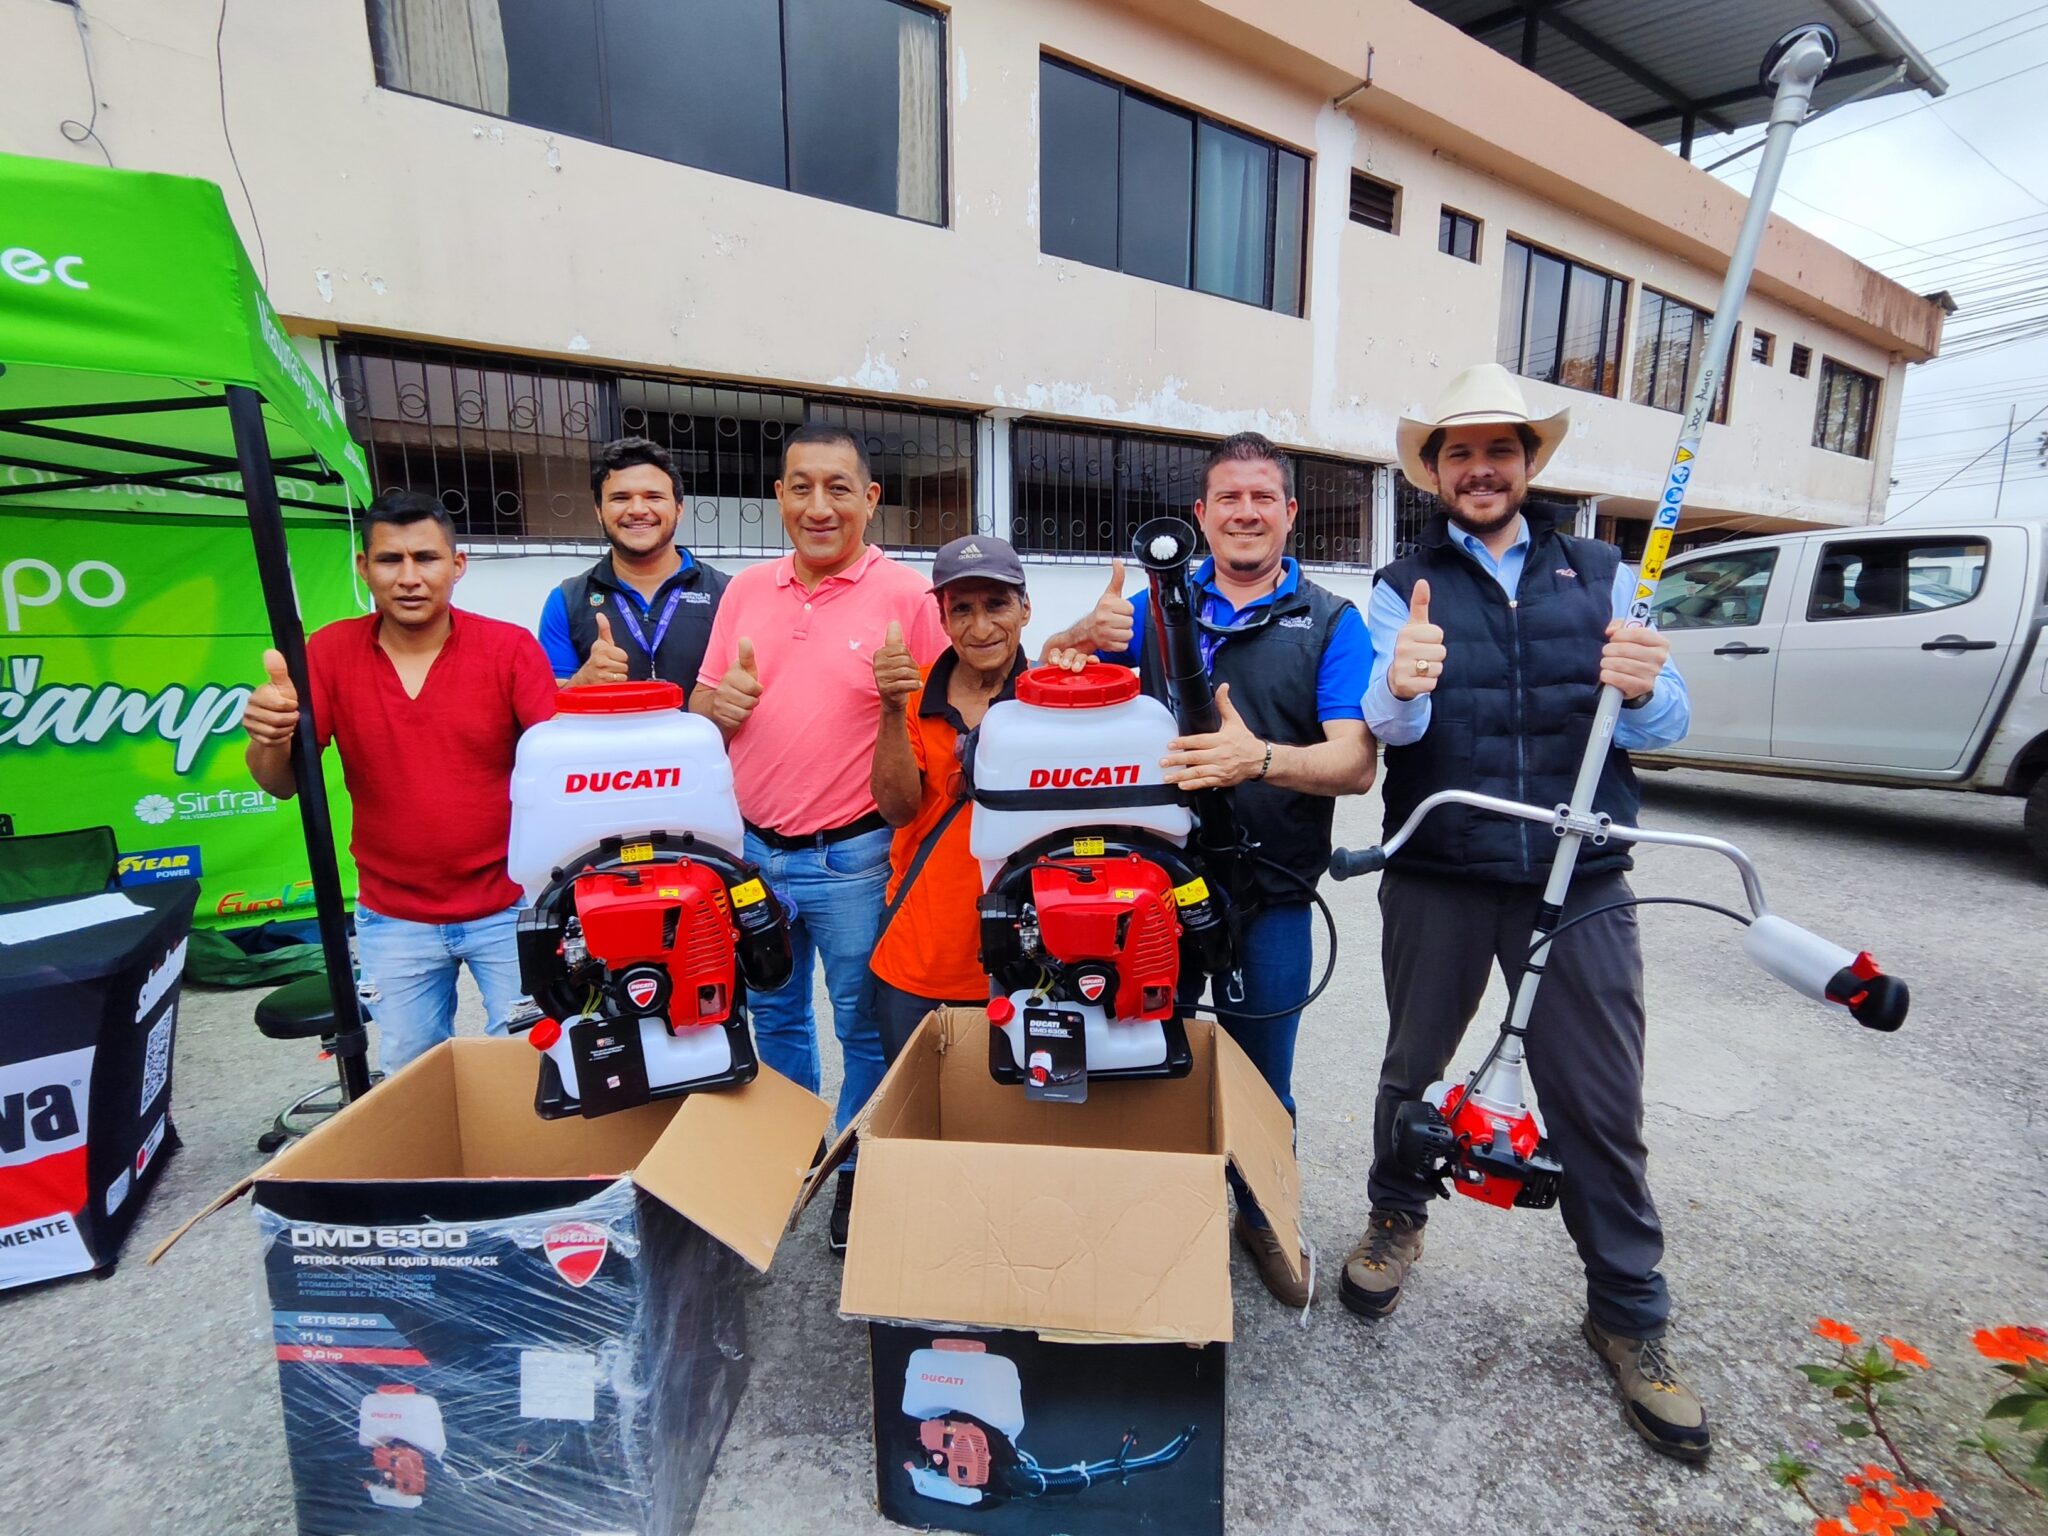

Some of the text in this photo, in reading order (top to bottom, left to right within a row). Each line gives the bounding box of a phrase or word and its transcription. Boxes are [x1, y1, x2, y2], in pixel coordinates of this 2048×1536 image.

[2, 558, 126, 632] po
[565, 767, 681, 793] DUCATI
[1029, 765, 1141, 789] DUCATI
[156, 868, 191, 879] POWER
[1030, 1020, 1060, 1028] DUCATI
[291, 1228, 468, 1249] DMD 6300
[549, 1231, 602, 1244] DUCATI
[293, 1255, 498, 1268] PETROL POWER LIQUID BACKPACK
[299, 1332, 334, 1344] 11 kg
[327, 1350, 344, 1361] hp
[921, 1373, 964, 1385] DUCATI
